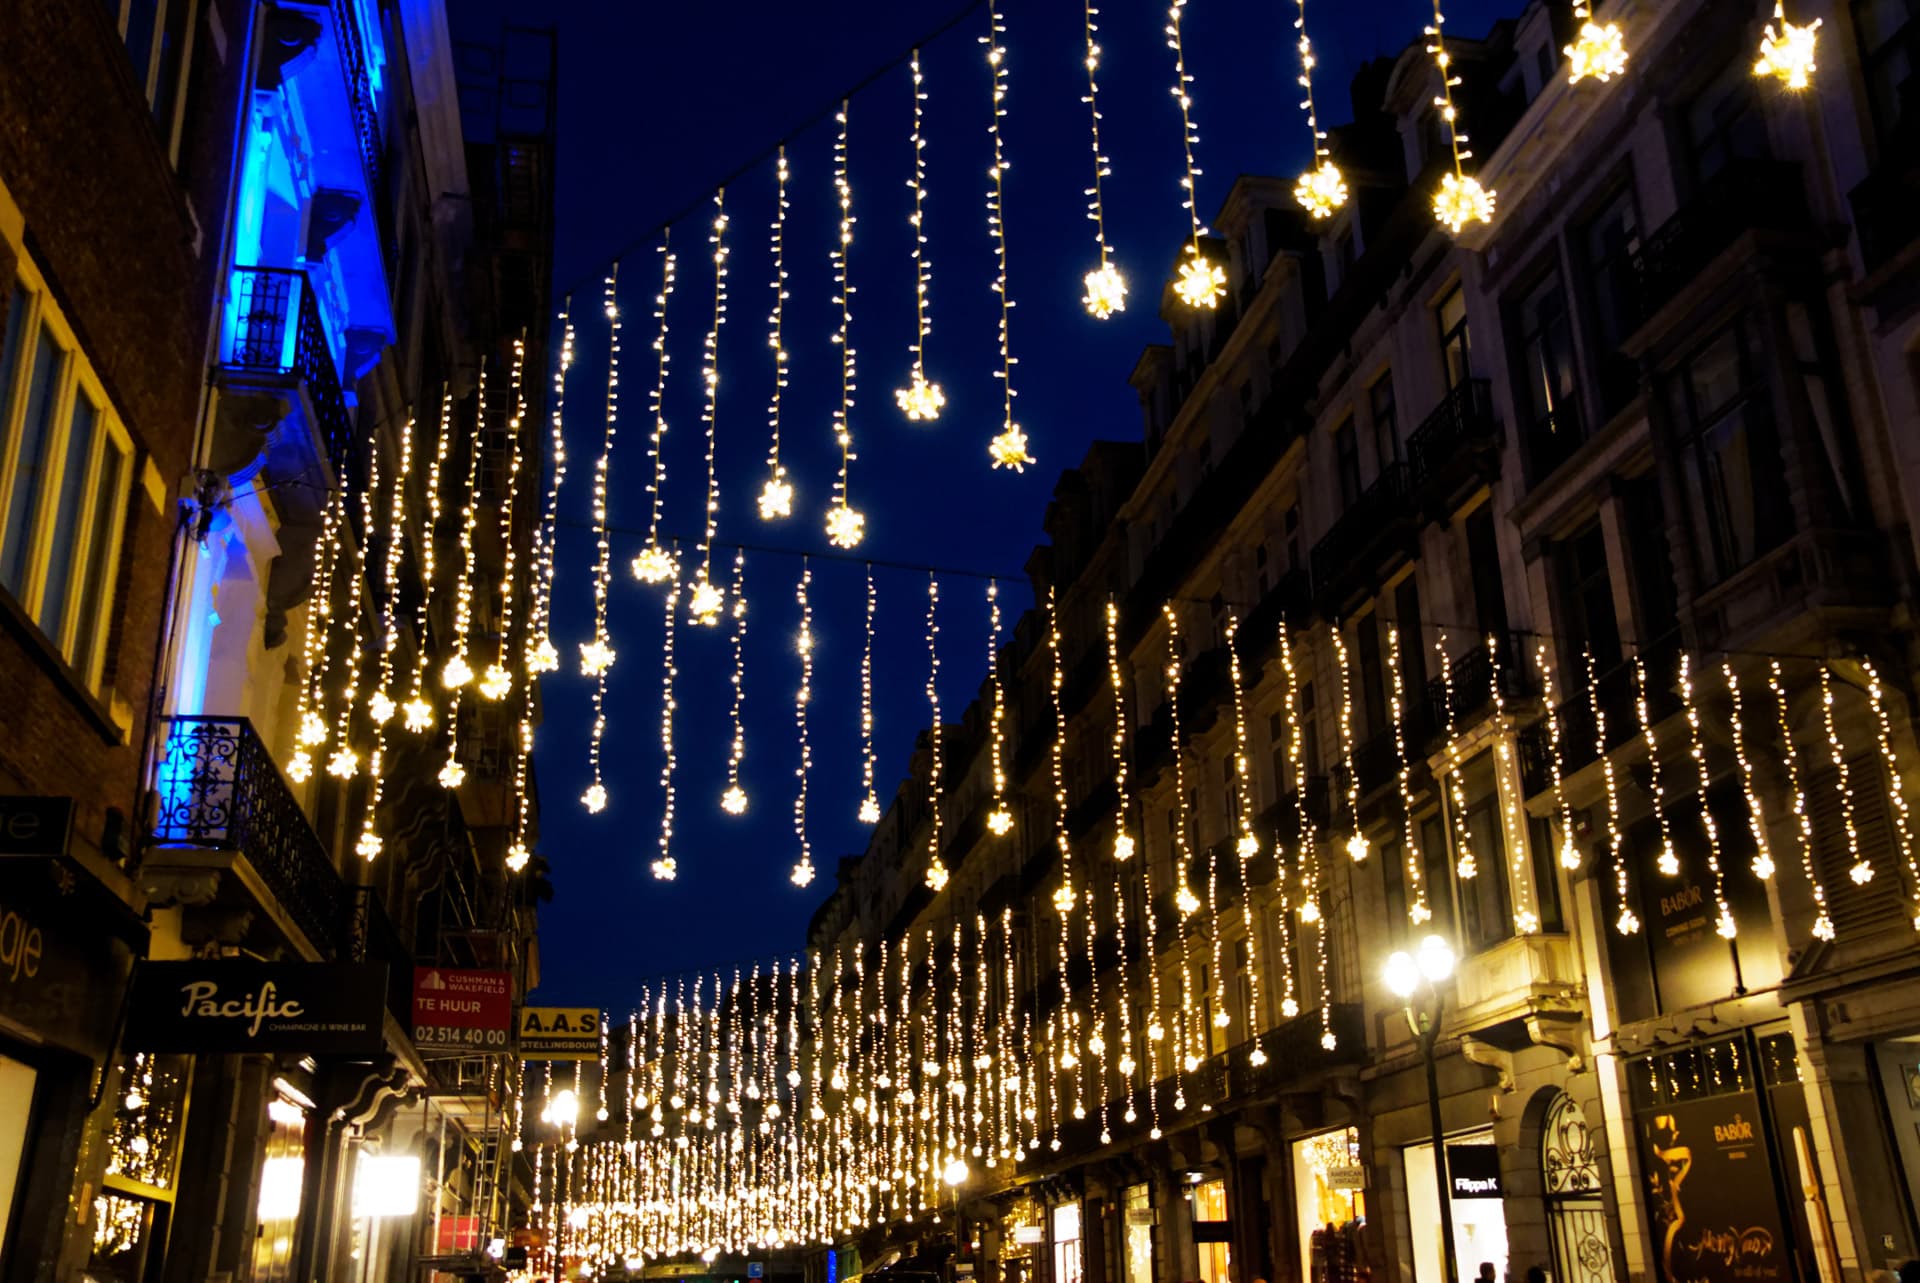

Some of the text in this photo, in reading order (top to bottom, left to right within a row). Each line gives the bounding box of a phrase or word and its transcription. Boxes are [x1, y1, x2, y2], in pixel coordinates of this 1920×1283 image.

[0, 906, 42, 982] aje
[449, 975, 497, 986] CUSHMAN
[449, 983, 505, 994] WAKEFIELD
[181, 981, 305, 1037] Pacific
[417, 998, 481, 1014] TE HUUR
[268, 1023, 320, 1032] CHAMPAGNE
[328, 1023, 349, 1032] WINE
[351, 1023, 367, 1032] BAR
[524, 1013, 596, 1033] A.A.S
[415, 1026, 506, 1045] 02 514 40 00
[521, 1041, 598, 1049] STELLINGBOUW
[1488, 1177, 1498, 1190] K
